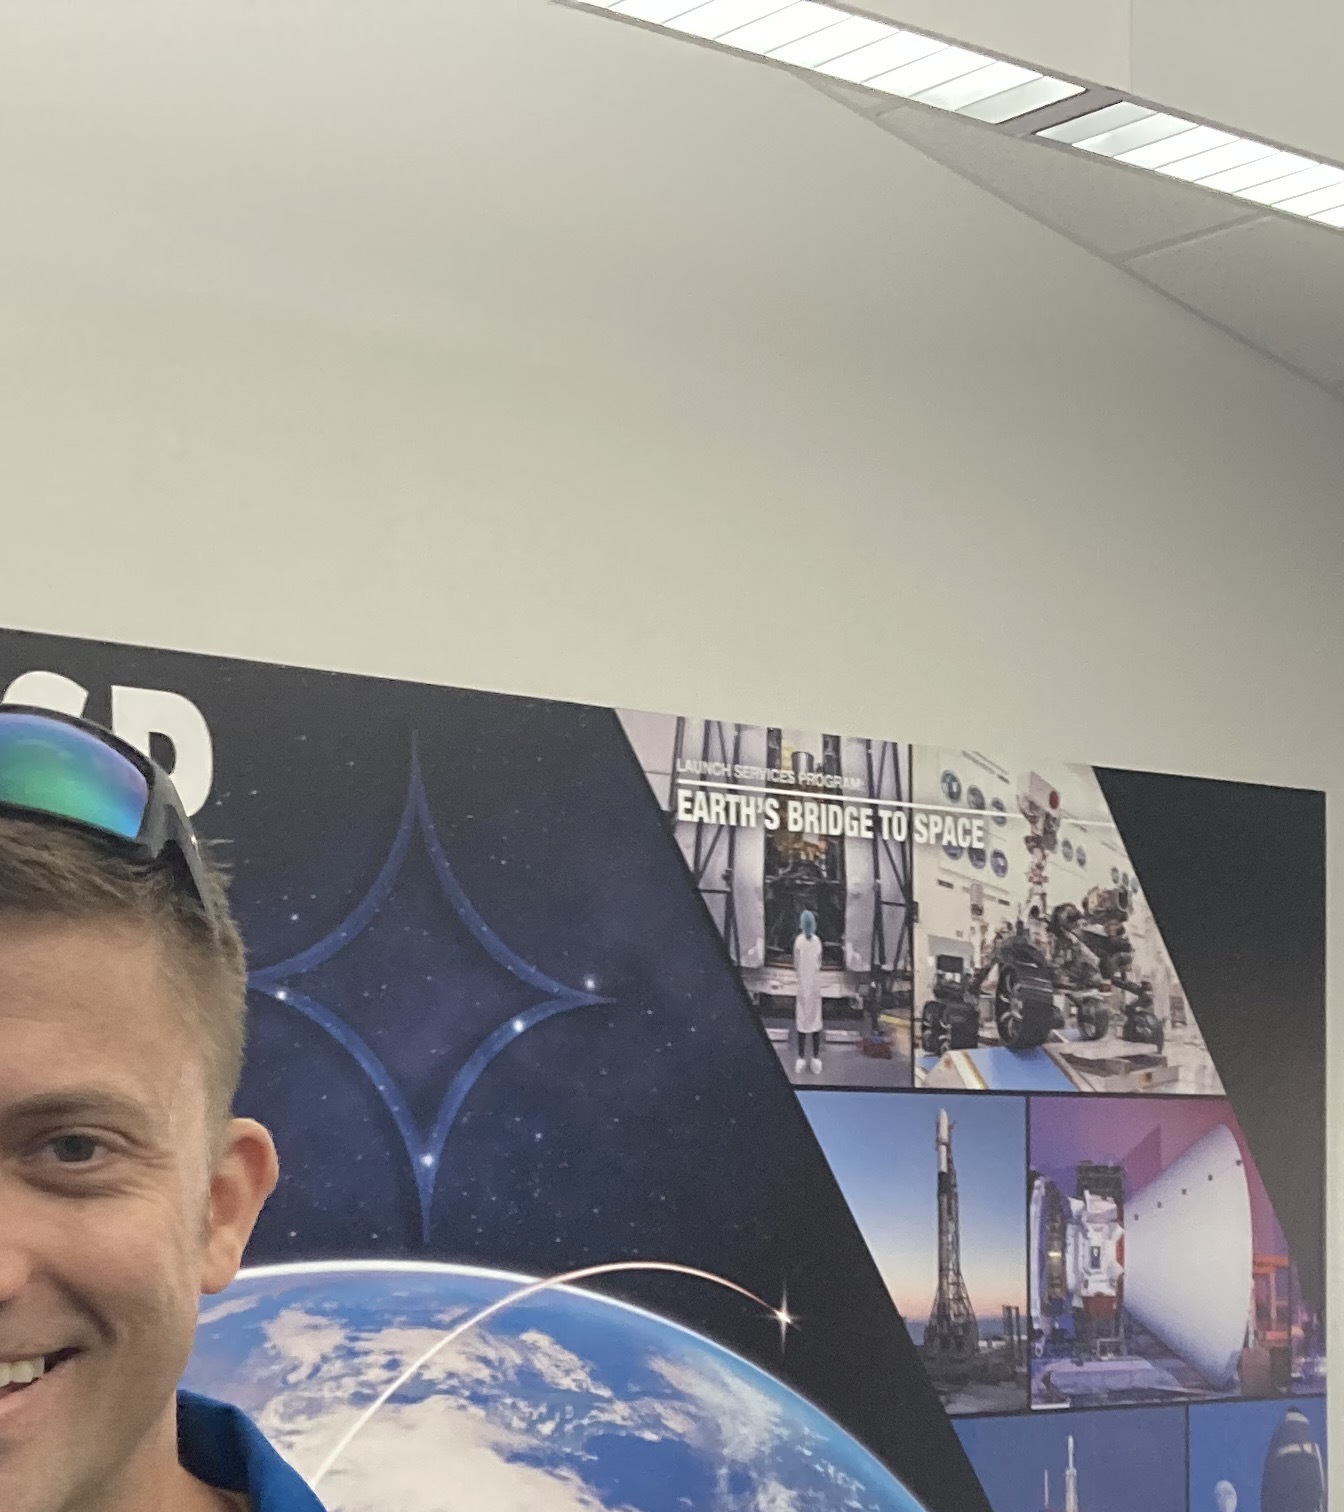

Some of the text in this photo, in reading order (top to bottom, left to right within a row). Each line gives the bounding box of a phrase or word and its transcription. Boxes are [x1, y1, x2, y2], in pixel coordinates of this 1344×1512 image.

[676, 757, 732, 778] LAUNCH
[734, 763, 796, 785] SERVICES
[677, 788, 985, 849] EARTH'S BRIDGE TO SPACE
